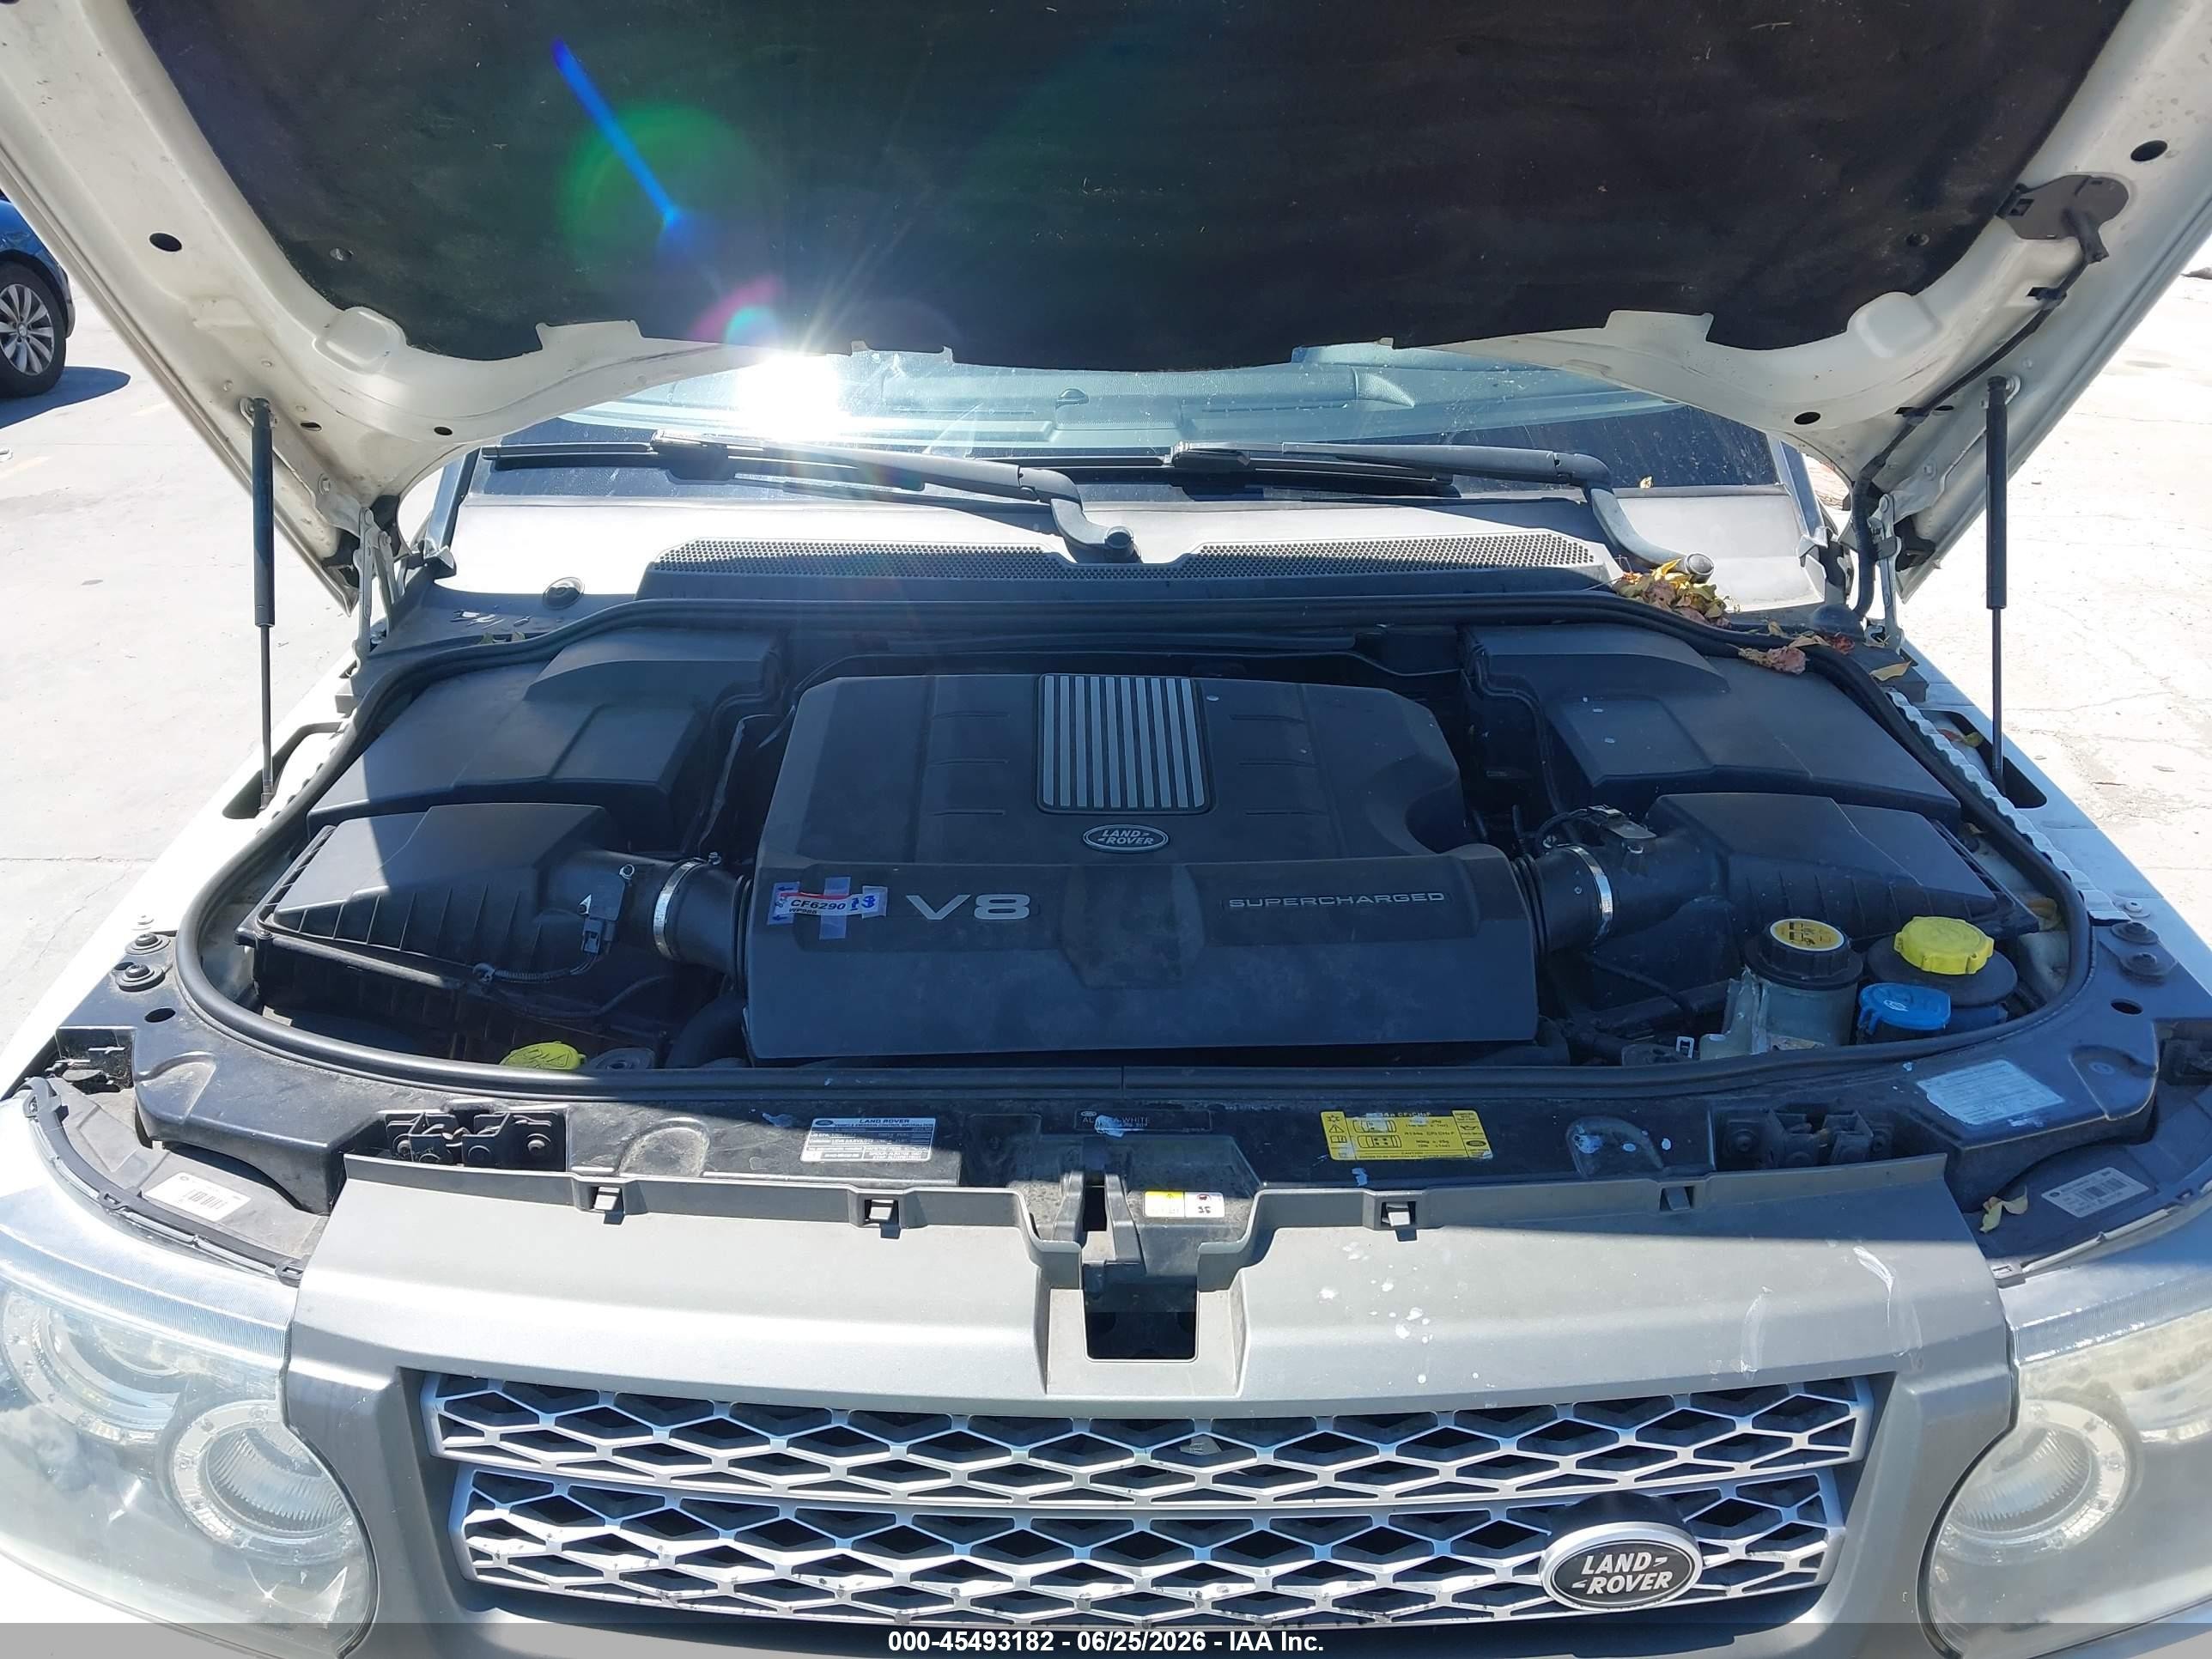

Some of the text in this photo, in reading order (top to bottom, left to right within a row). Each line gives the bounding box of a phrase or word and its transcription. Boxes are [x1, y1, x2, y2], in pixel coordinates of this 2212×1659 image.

[1105, 836, 1154, 845] ROVER
[790, 898, 846, 910] CF6290
[905, 894, 1030, 921] V8
[1229, 892, 1445, 908] SUPERCHARGED
[1581, 1552, 1652, 1575] LAND
[1586, 1571, 1674, 1595] ROVER
